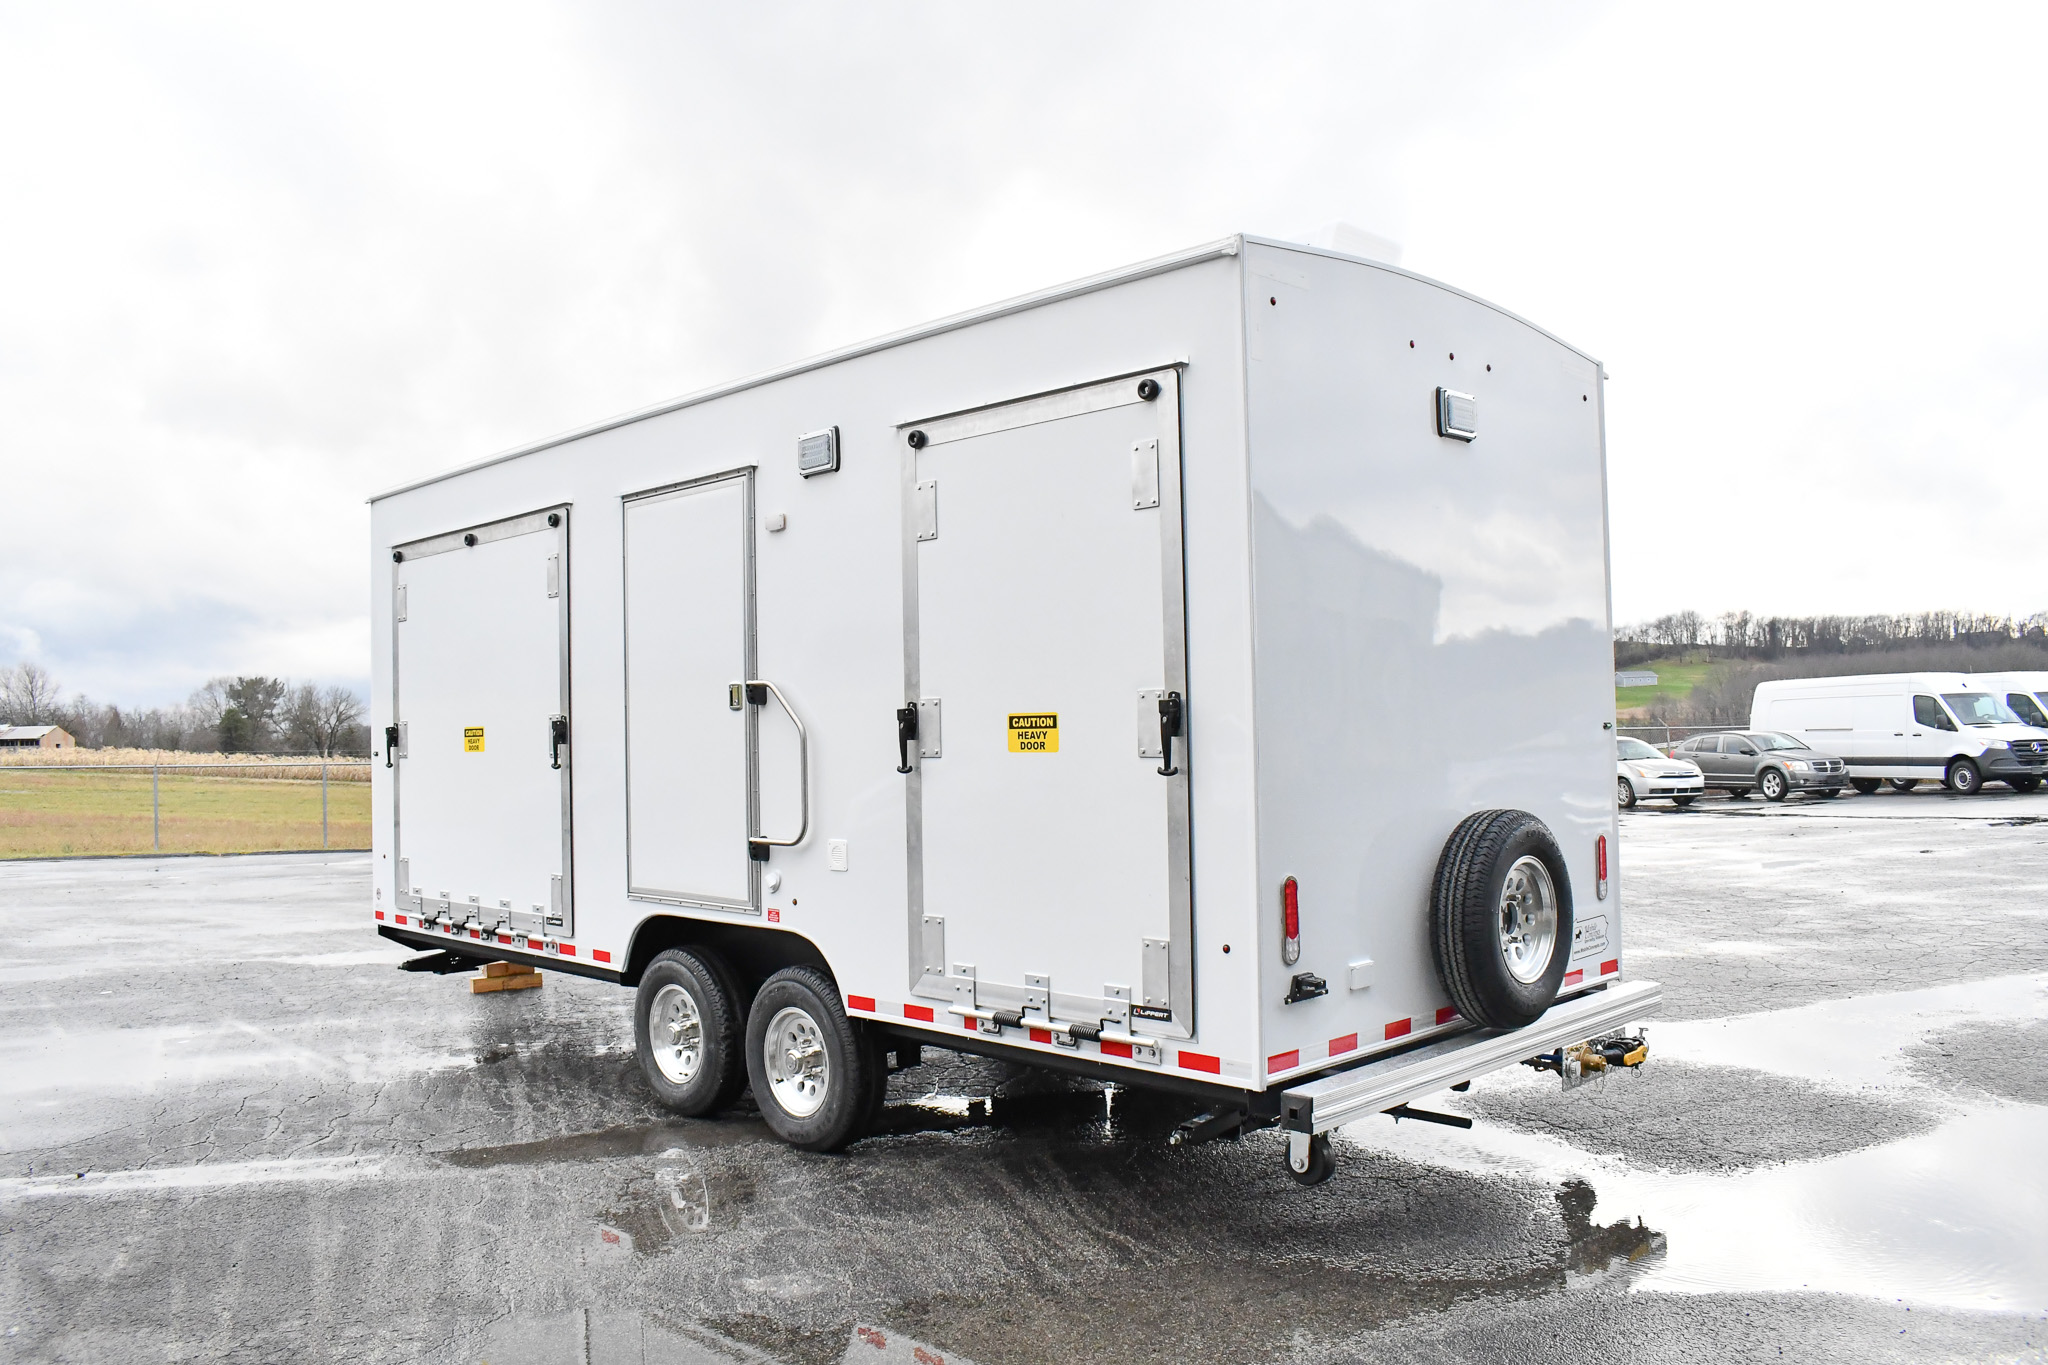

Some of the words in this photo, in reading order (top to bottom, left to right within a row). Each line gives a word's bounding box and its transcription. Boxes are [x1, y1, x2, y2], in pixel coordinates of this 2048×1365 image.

[1012, 717, 1054, 727] CAUTION
[1017, 731, 1048, 740] HEAVY
[1020, 741, 1046, 750] DOOR
